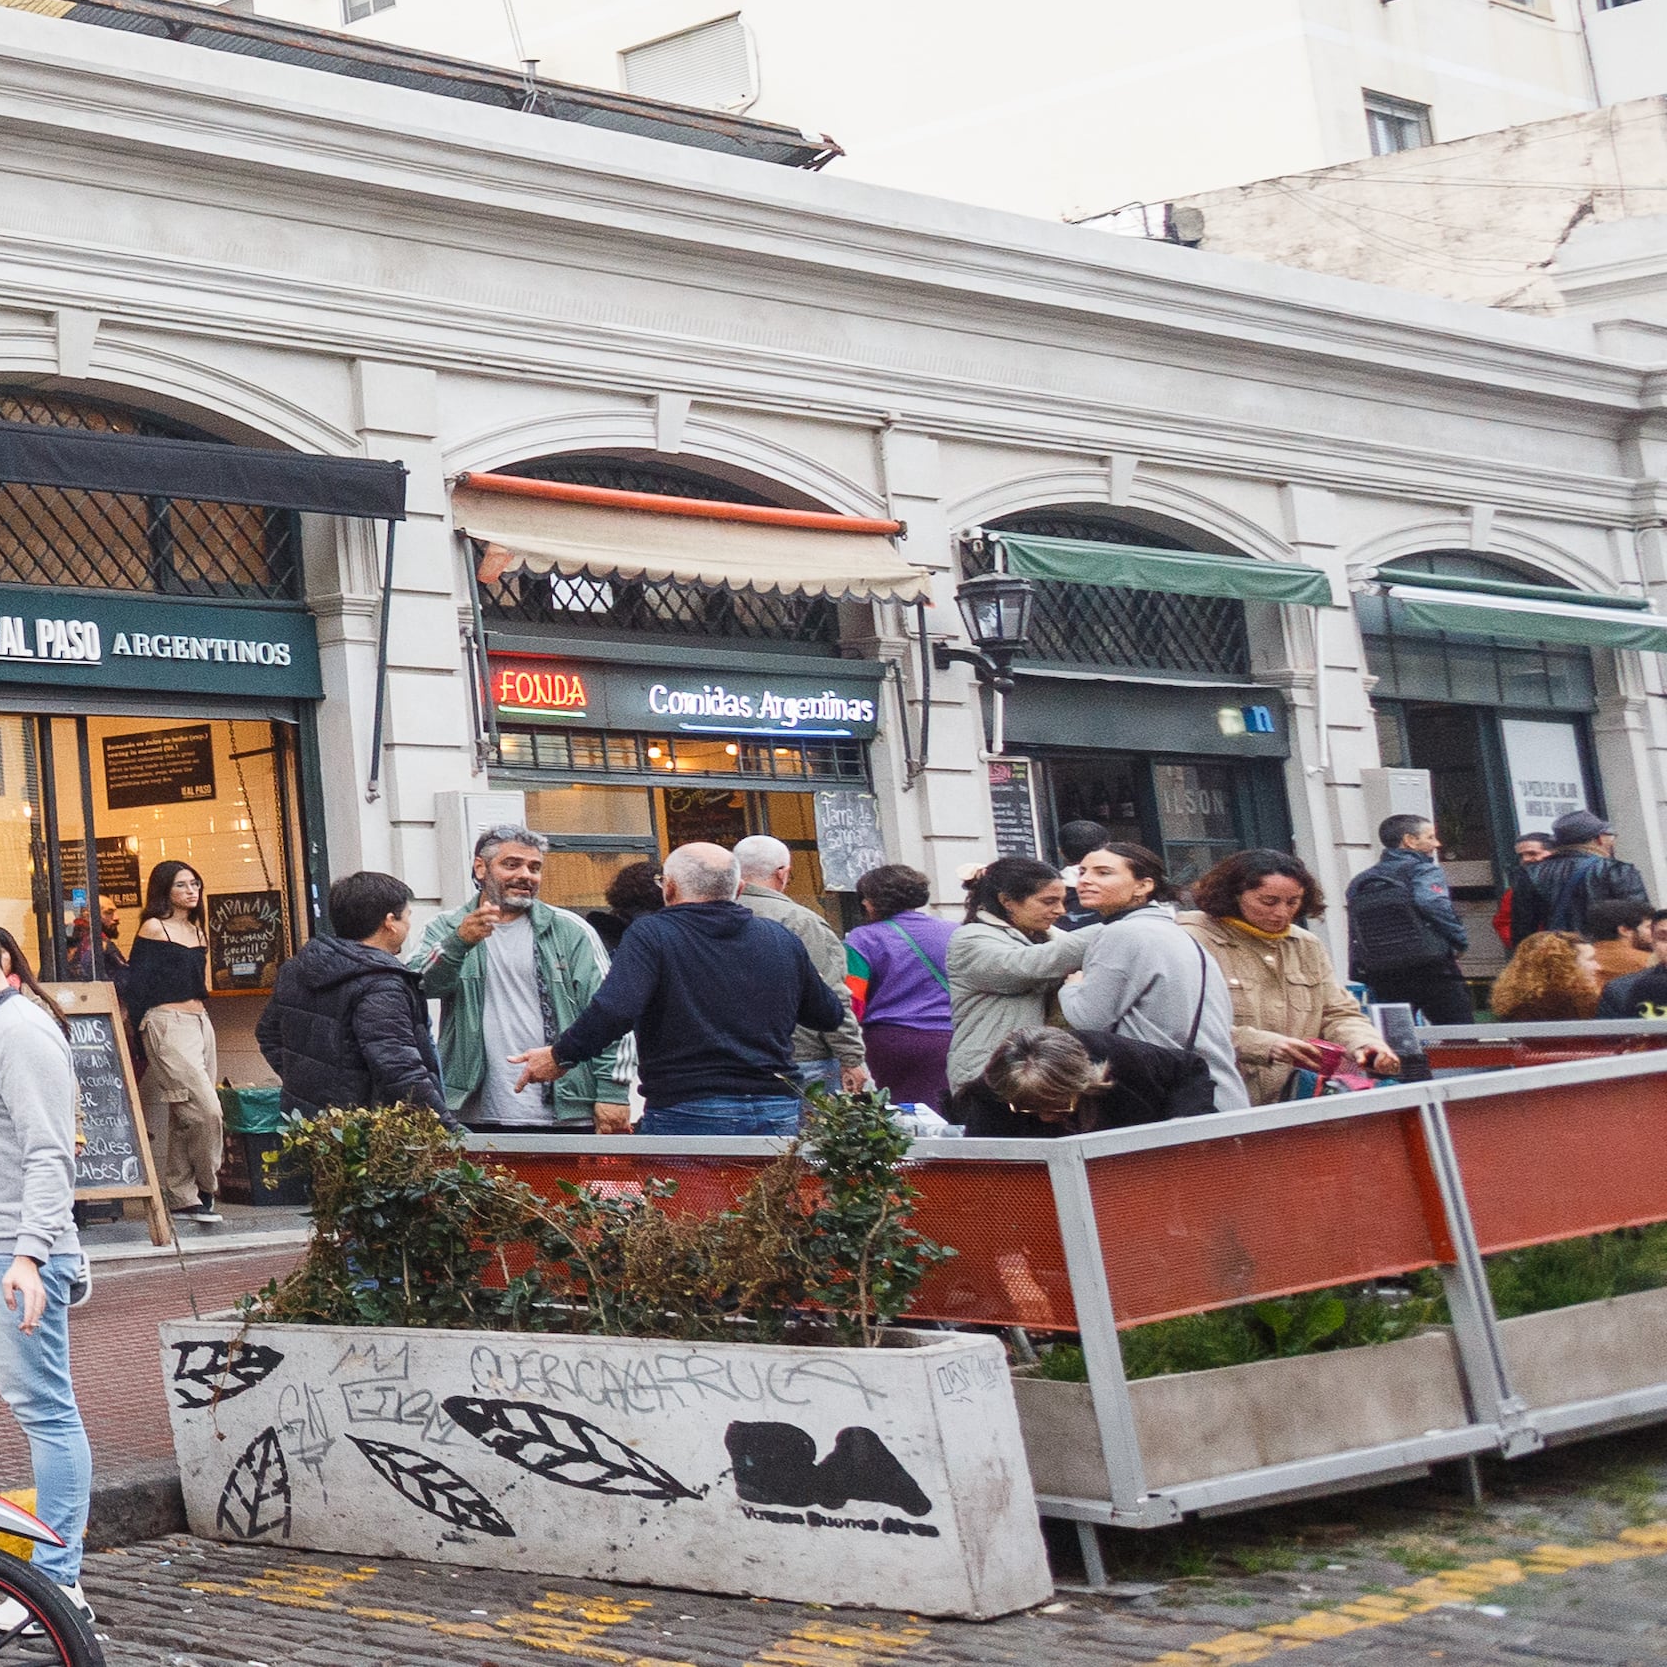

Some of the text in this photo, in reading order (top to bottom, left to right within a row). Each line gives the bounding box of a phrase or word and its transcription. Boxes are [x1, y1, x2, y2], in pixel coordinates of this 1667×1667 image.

[35, 618, 102, 661] PASO
[112, 632, 293, 666] ARGENTINOS
[500, 671, 587, 707] FONDA
[648, 684, 874, 728] Comidas Argentinas
